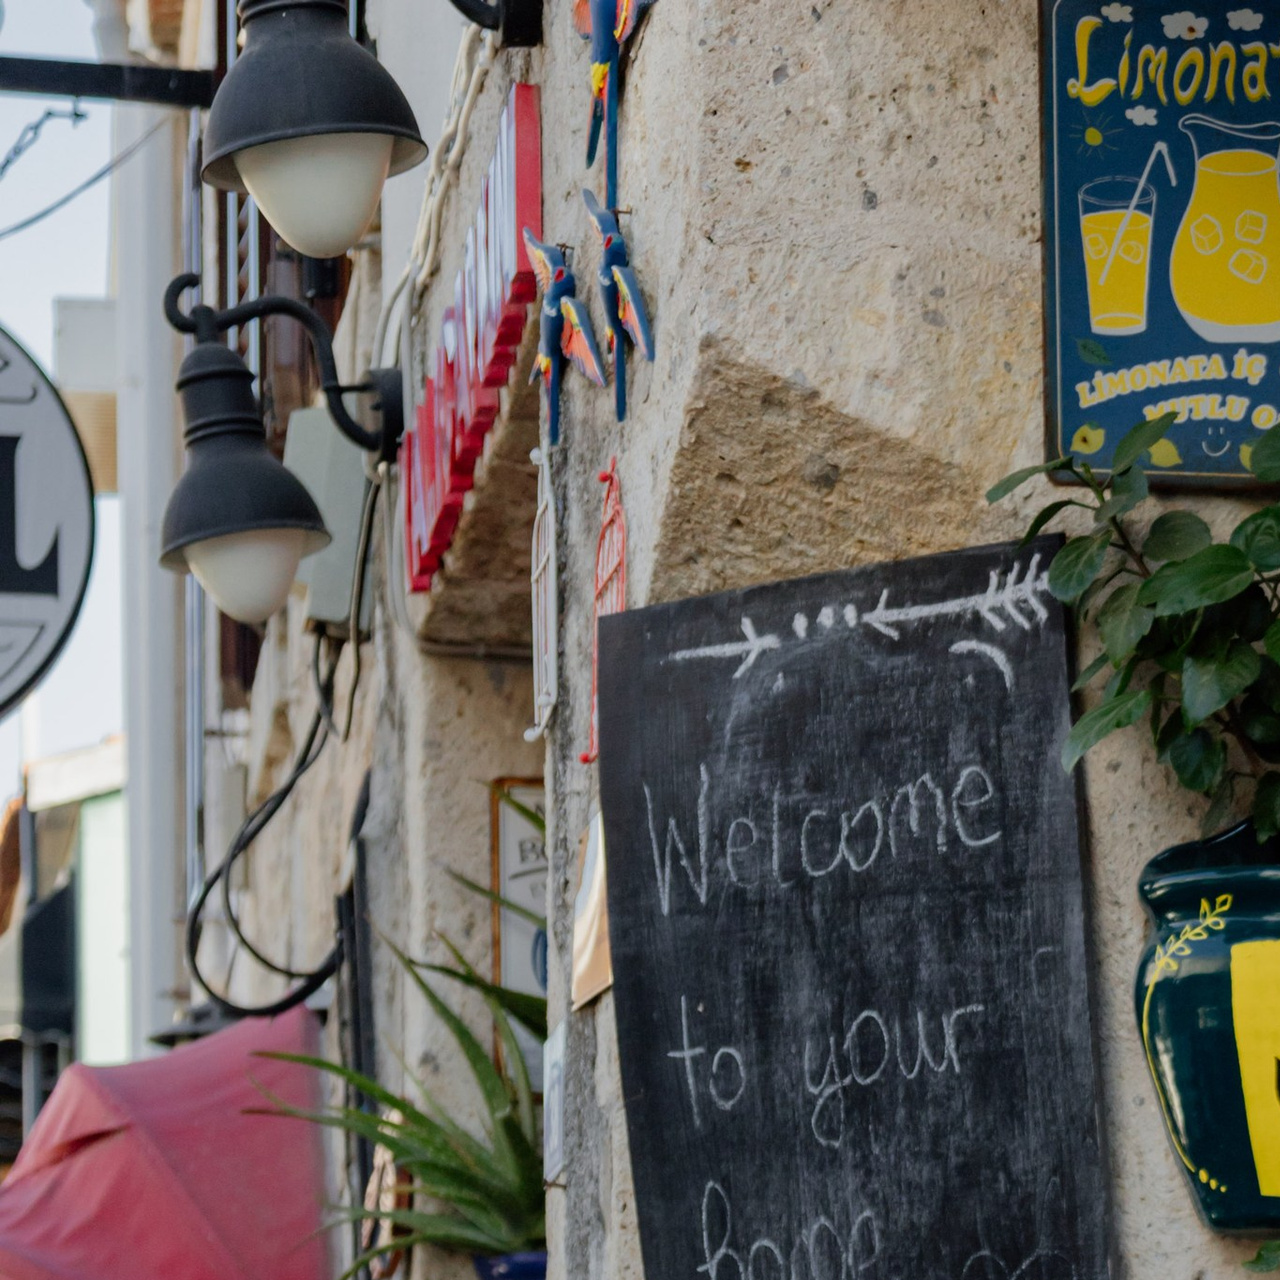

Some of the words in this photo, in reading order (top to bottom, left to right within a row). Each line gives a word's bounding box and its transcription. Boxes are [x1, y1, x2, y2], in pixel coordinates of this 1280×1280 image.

[1075, 353, 1228, 409] LİMONATA
[643, 763, 1001, 916] Welcome
[668, 996, 746, 1128] to
[805, 1004, 985, 1148] your
